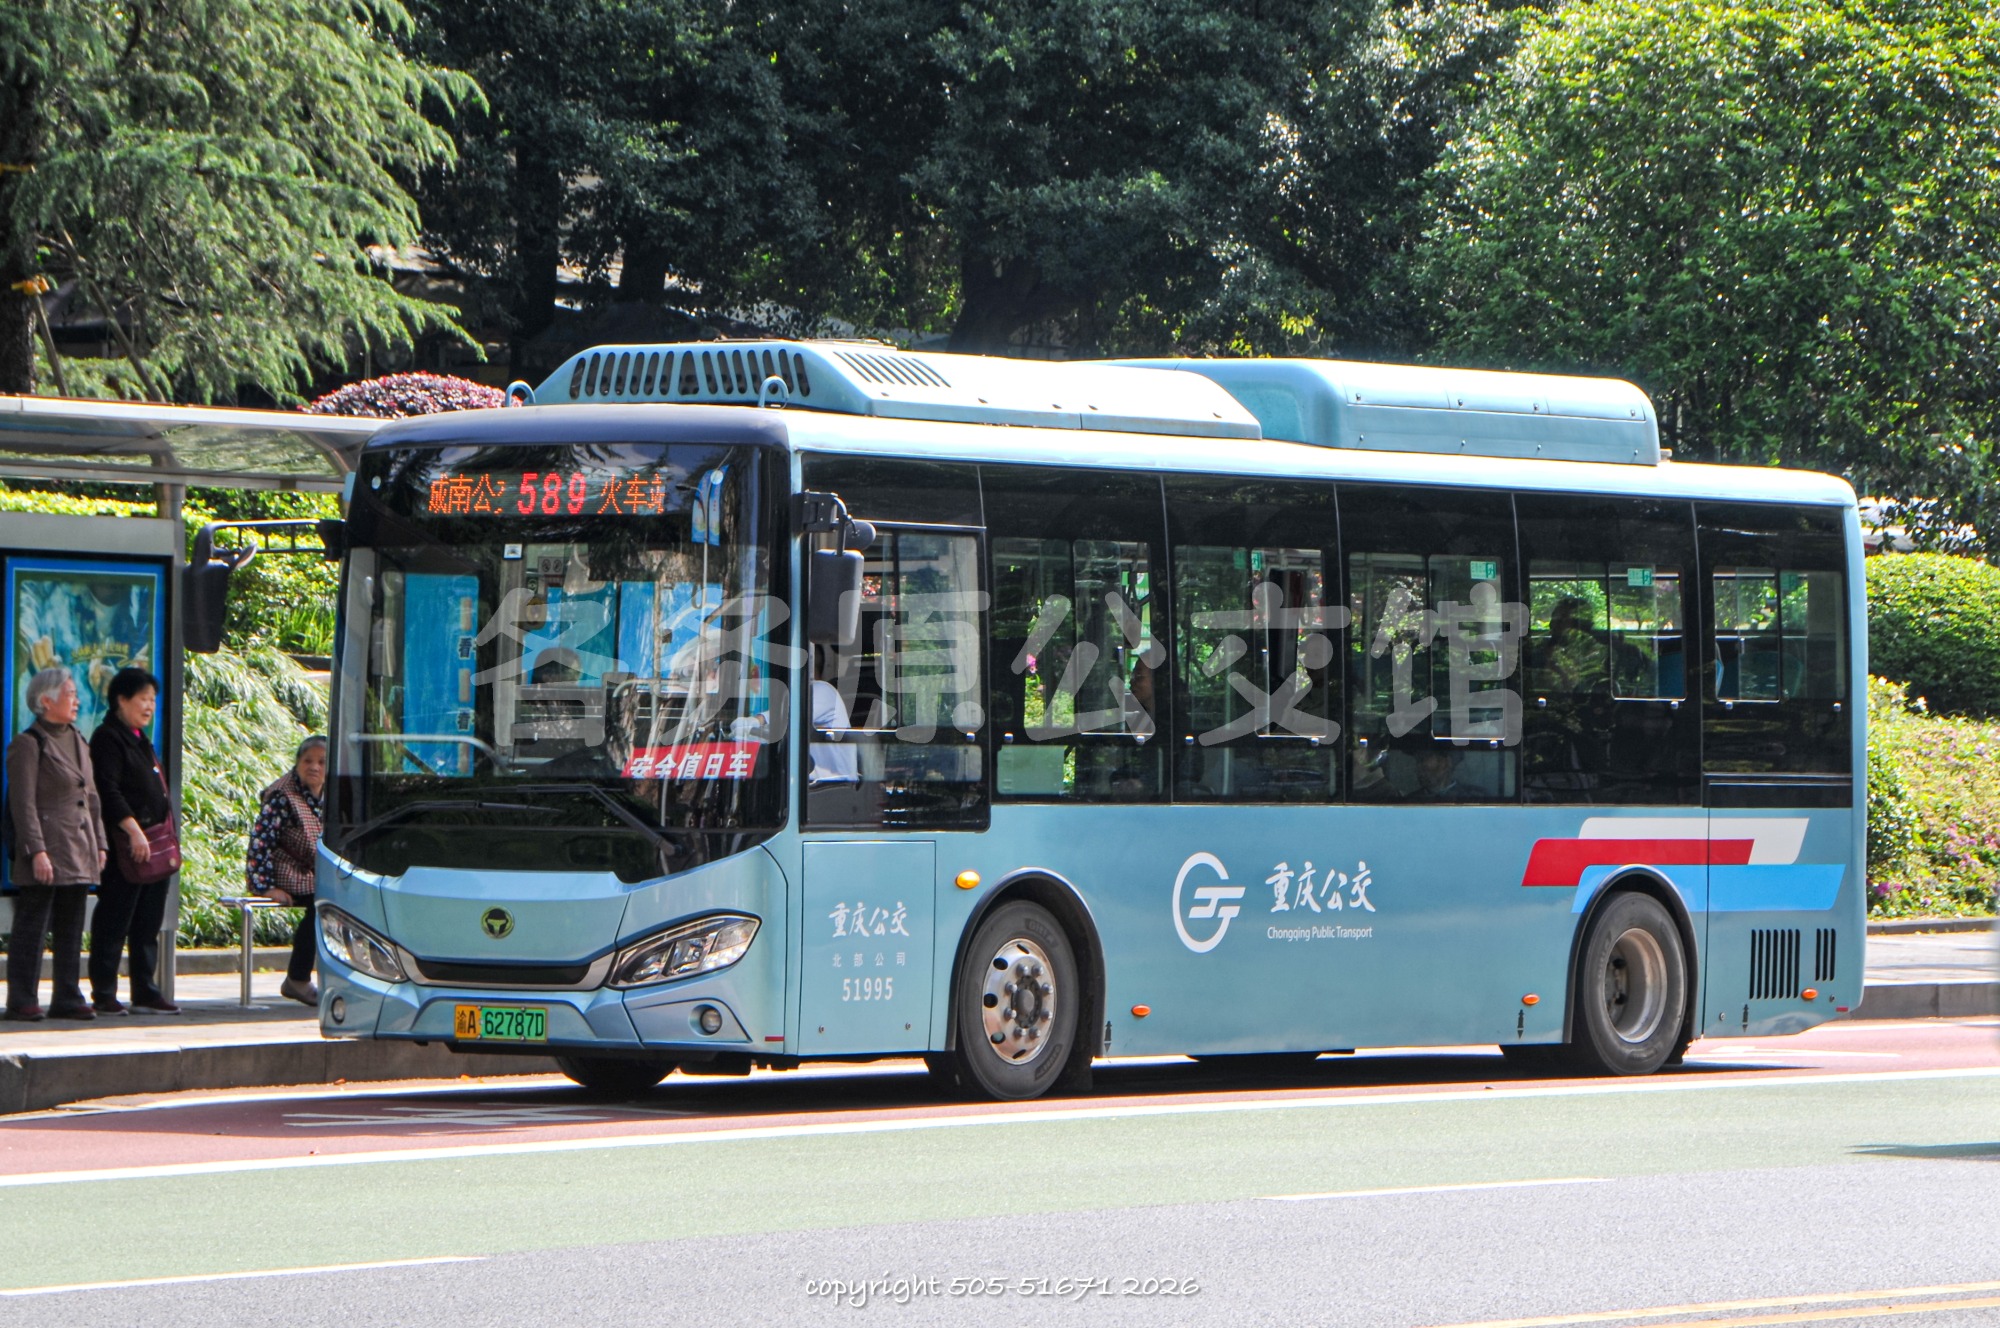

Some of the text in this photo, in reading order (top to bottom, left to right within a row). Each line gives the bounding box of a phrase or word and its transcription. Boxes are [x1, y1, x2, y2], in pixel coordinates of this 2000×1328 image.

[517, 472, 587, 515] 589
[630, 750, 752, 780] 安全值日车
[1265, 861, 1376, 913] 重庆公交
[828, 901, 910, 938] 重庆公交
[1267, 926, 1373, 942] Chongqing Public Transport
[832, 951, 906, 968] 北部公司
[842, 977, 894, 1002] 51995
